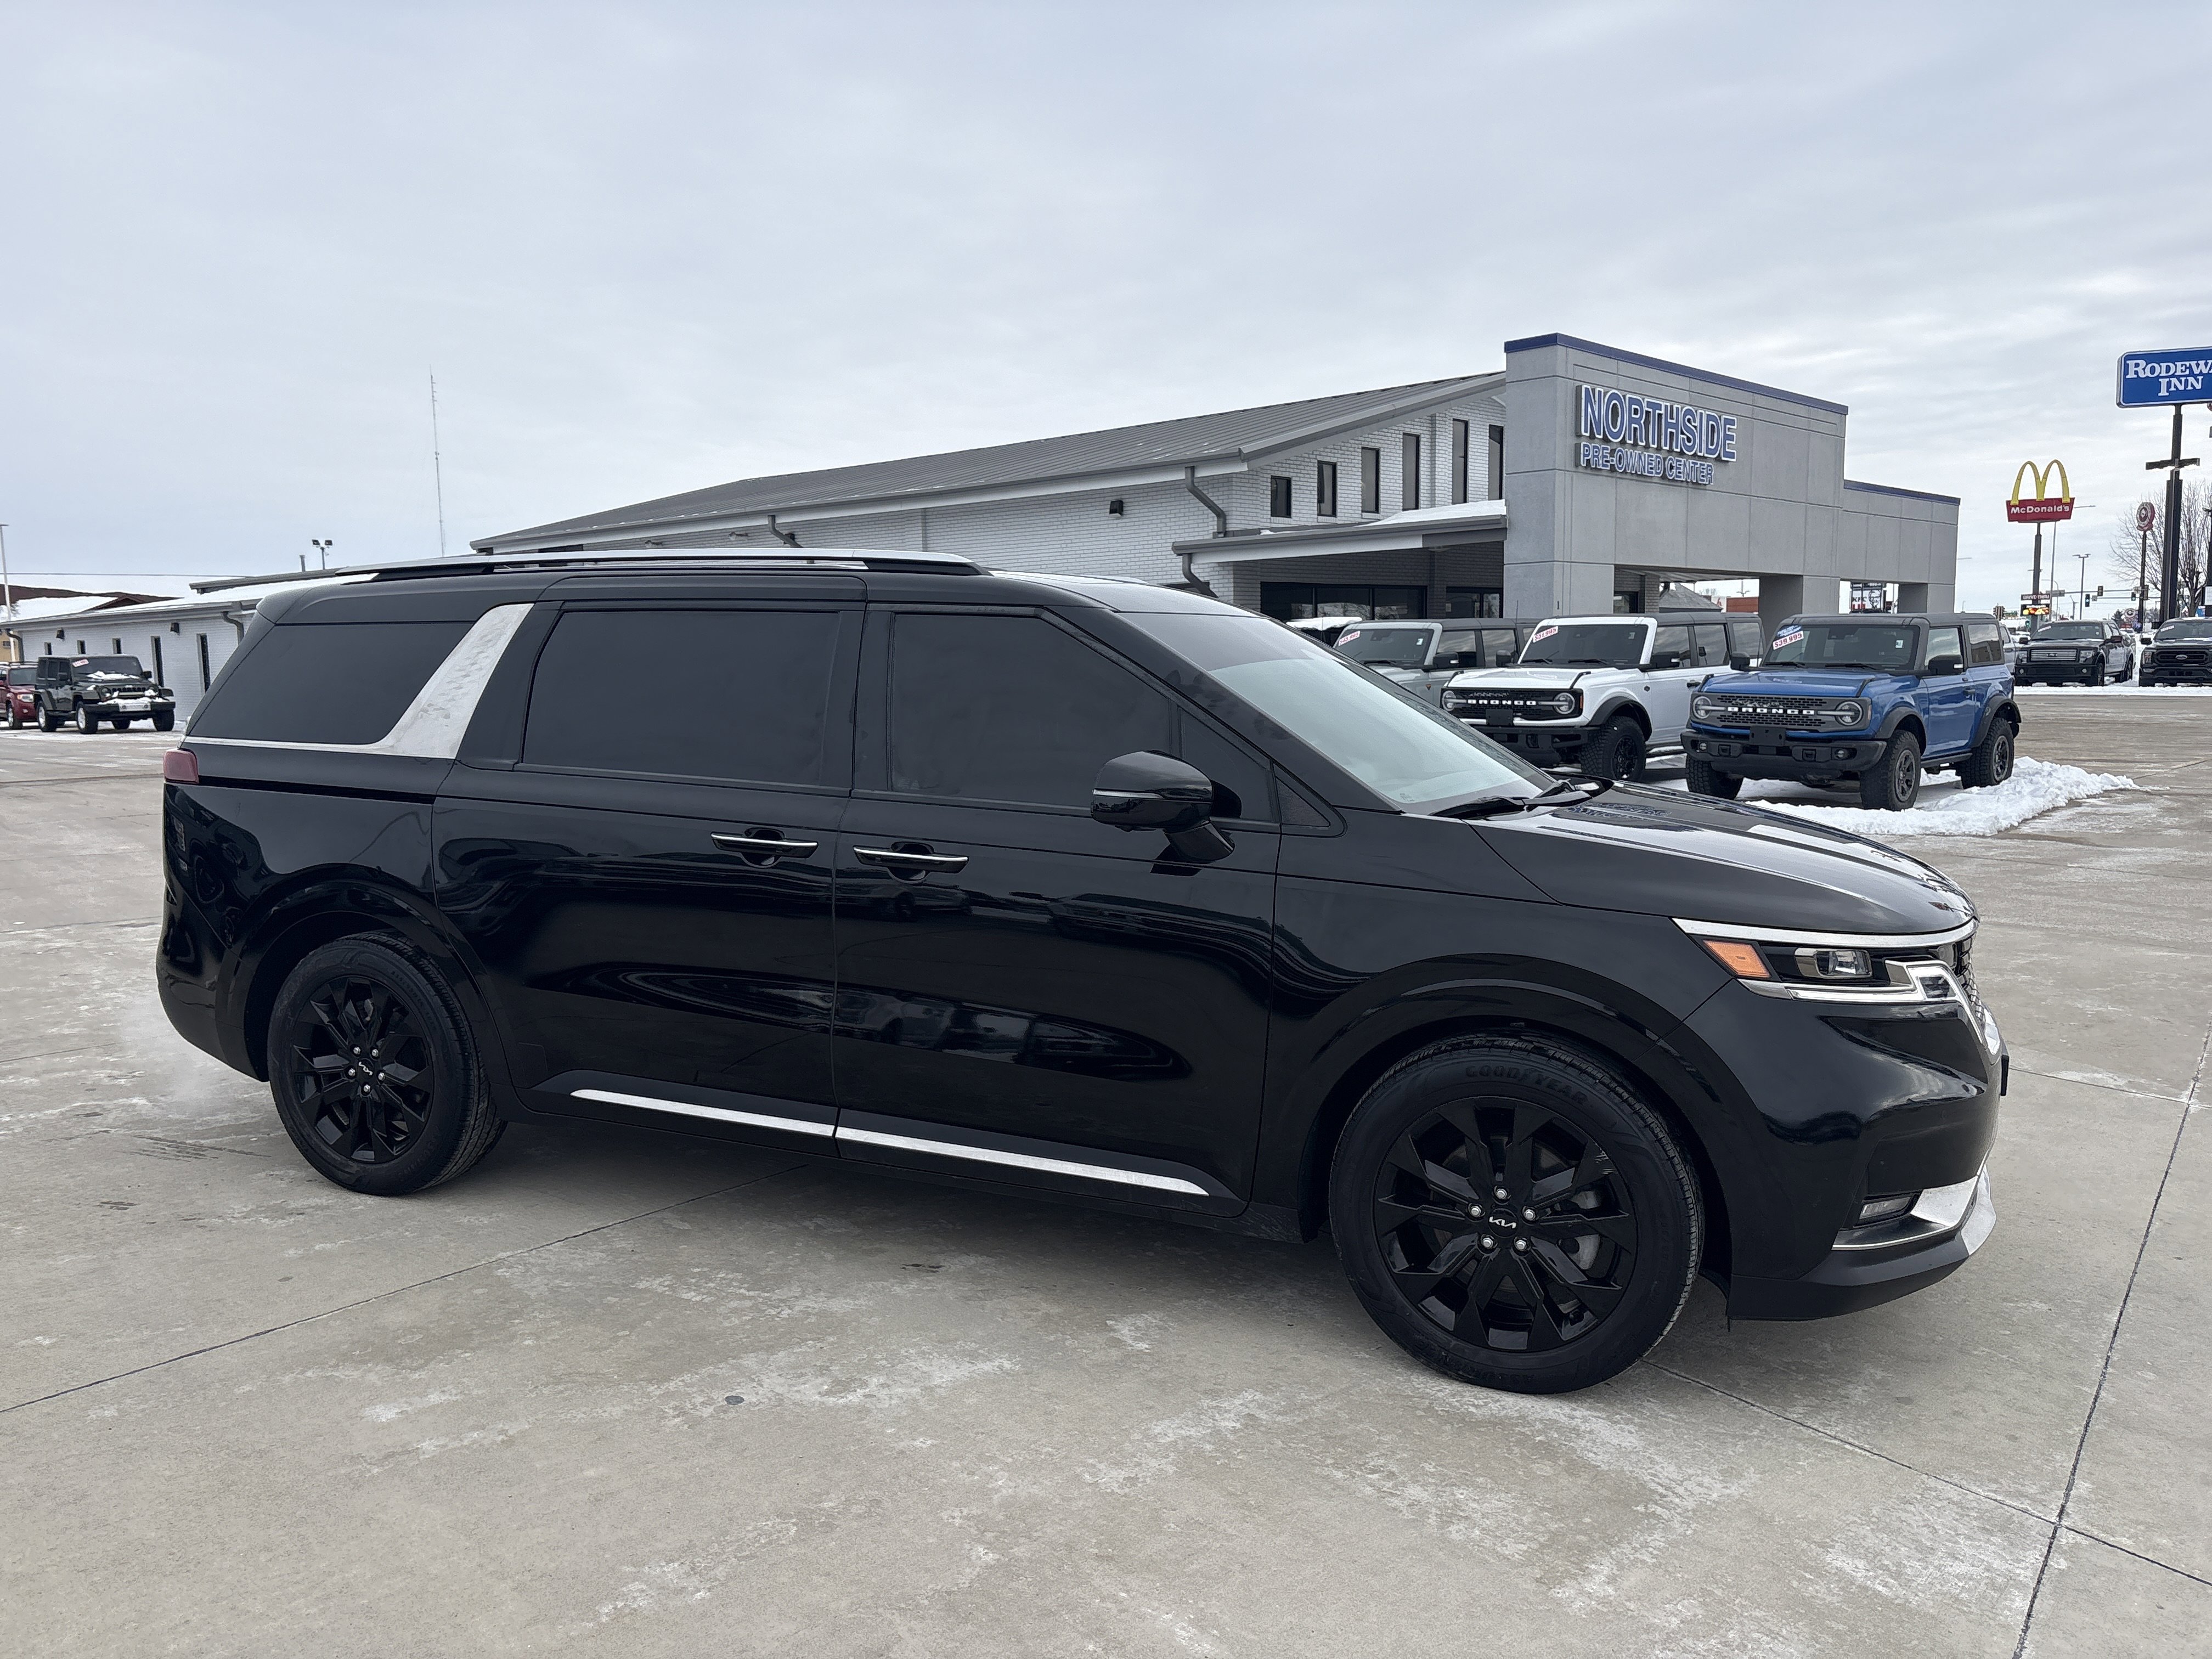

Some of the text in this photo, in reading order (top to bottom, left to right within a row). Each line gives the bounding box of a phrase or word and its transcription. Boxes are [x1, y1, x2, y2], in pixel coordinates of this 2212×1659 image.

[2125, 359, 2212, 379] RODEW
[2158, 375, 2204, 397] INN
[1581, 385, 1737, 461] NORTHSIDE
[1580, 442, 1714, 485] PRE-OWNED CENTER
[2010, 504, 2070, 514] McDonald's
[1727, 706, 1815, 715] BRONCO
[1465, 1064, 1589, 1105] GOODYEAR
